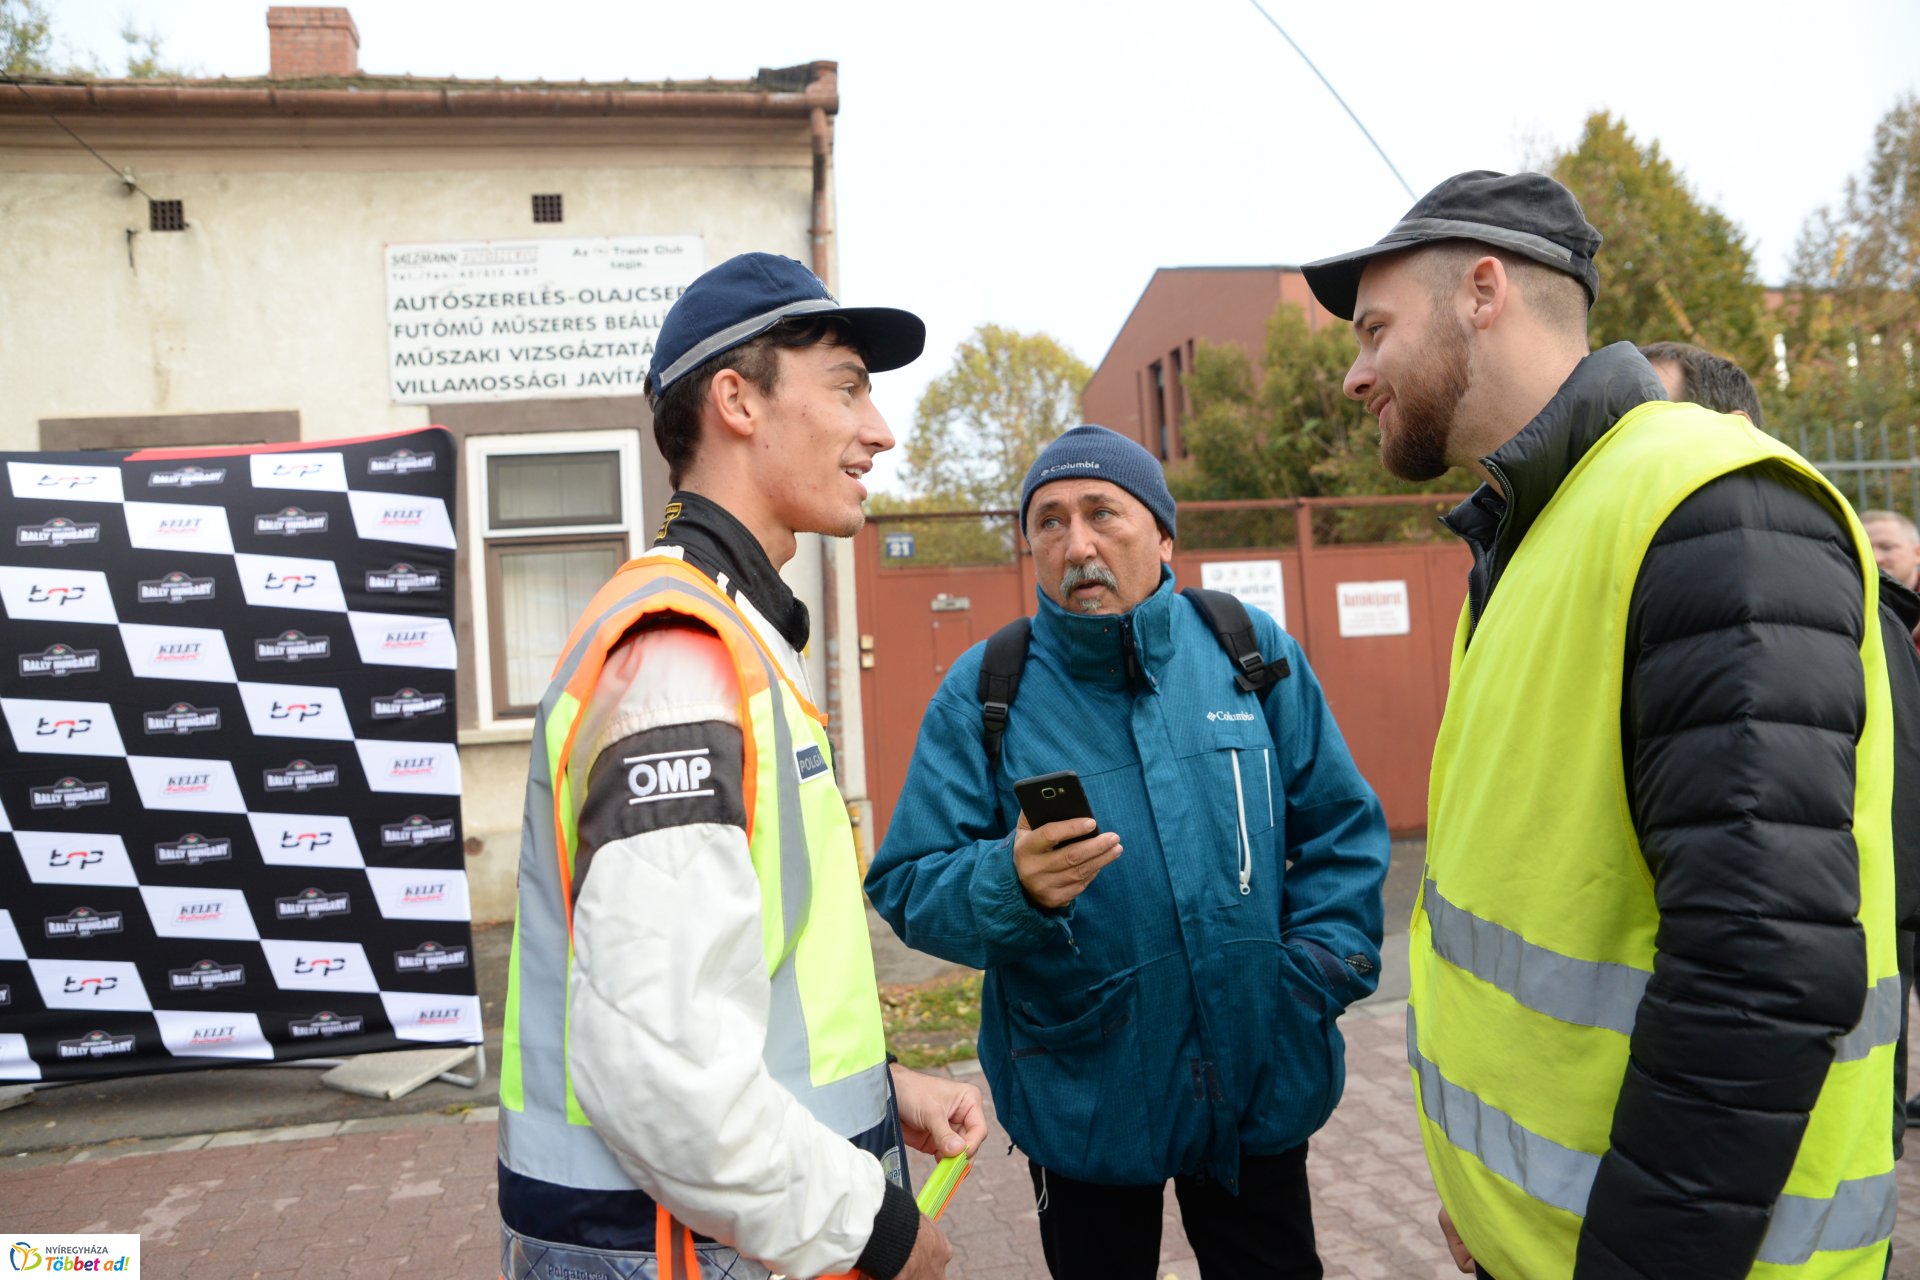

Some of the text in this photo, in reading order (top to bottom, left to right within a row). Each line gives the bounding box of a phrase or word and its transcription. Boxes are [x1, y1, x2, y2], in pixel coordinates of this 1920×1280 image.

[396, 369, 566, 394] VILLAMOSSÁGI
[371, 457, 433, 471] RALLY HUNGARY
[1050, 460, 1100, 472] Columbia
[153, 472, 223, 485] RALLY HUNGARY
[384, 509, 424, 519] KELET
[160, 518, 202, 528] KELET
[258, 517, 325, 530] RALLY HUNGARY
[20, 527, 97, 542] RALLY HUNGARY
[369, 574, 437, 588] RALLY HUNGARY
[141, 583, 212, 598] RALLY HUNGARY
[386, 631, 427, 641] KELET
[159, 643, 201, 654] KELET
[258, 640, 327, 656] RALLY HUNGARY
[23, 659, 51, 672] RALLY
[53, 655, 97, 669] HUNGARY
[374, 698, 443, 714] RALLY HUNGARY
[147, 712, 218, 730] RALLY HUNGARY
[1216, 710, 1255, 721] Columbia
[394, 757, 434, 769] KELET
[167, 774, 210, 786] KELET
[267, 769, 336, 787] RALLY HUNGARY
[627, 756, 712, 797] OMP
[34, 792, 62, 805] RALLY
[64, 787, 107, 802] HUNGARY
[385, 823, 452, 842] RALLY HUNGARY
[159, 848, 186, 861] RALLY
[187, 843, 229, 858] HUNGARY
[405, 884, 445, 896] KELET
[180, 902, 223, 915] KELET
[279, 897, 348, 915] RALLY HUNGARY
[48, 921, 75, 934] RALLY
[78, 916, 120, 931] HUNGARY
[398, 951, 465, 968] RALLY HUNGARY
[172, 973, 199, 987] RALLY
[201, 969, 242, 984] HUNGARY
[419, 1008, 461, 1020] KELET
[193, 1026, 236, 1039] KELET
[292, 1021, 361, 1037] RALLY HUNGARY
[61, 1039, 133, 1058] RALLY HUNGARY
